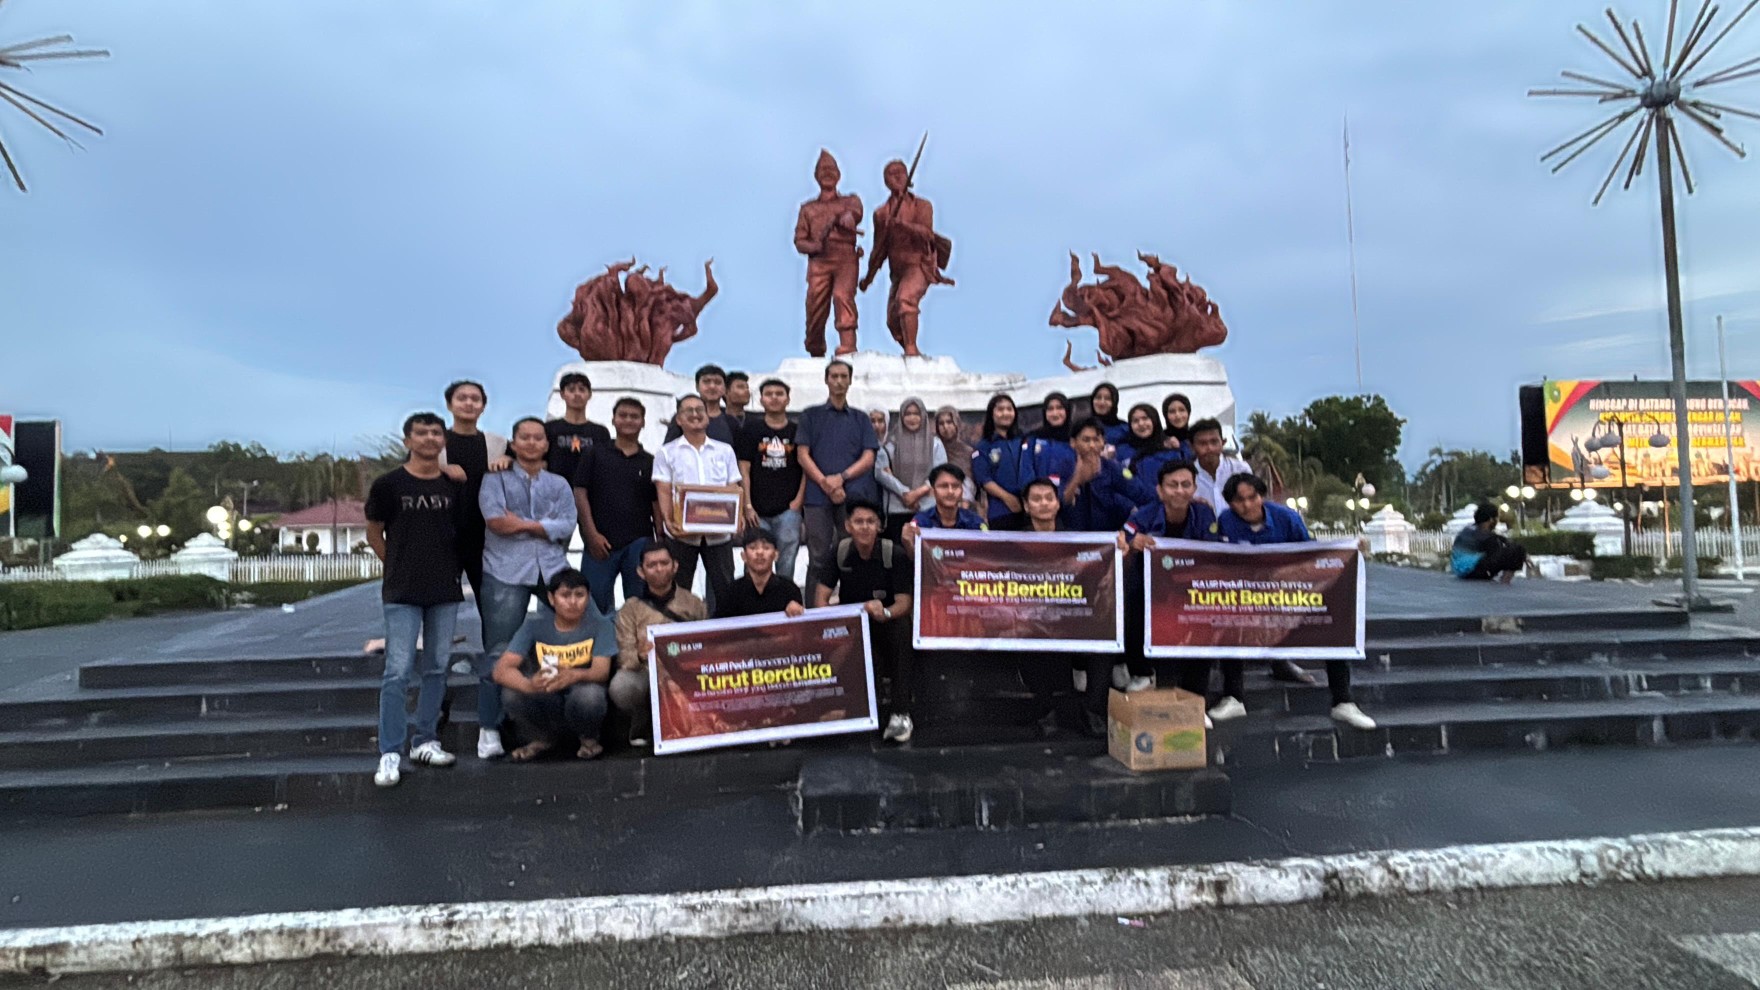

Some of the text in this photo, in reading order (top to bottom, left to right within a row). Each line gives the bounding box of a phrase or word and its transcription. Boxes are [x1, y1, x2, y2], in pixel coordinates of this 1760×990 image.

[957, 579, 1083, 598] Turut Berduka
[1187, 588, 1323, 607] Turut Berduka
[696, 669, 749, 692] Turut
[752, 662, 832, 686] Berduka
